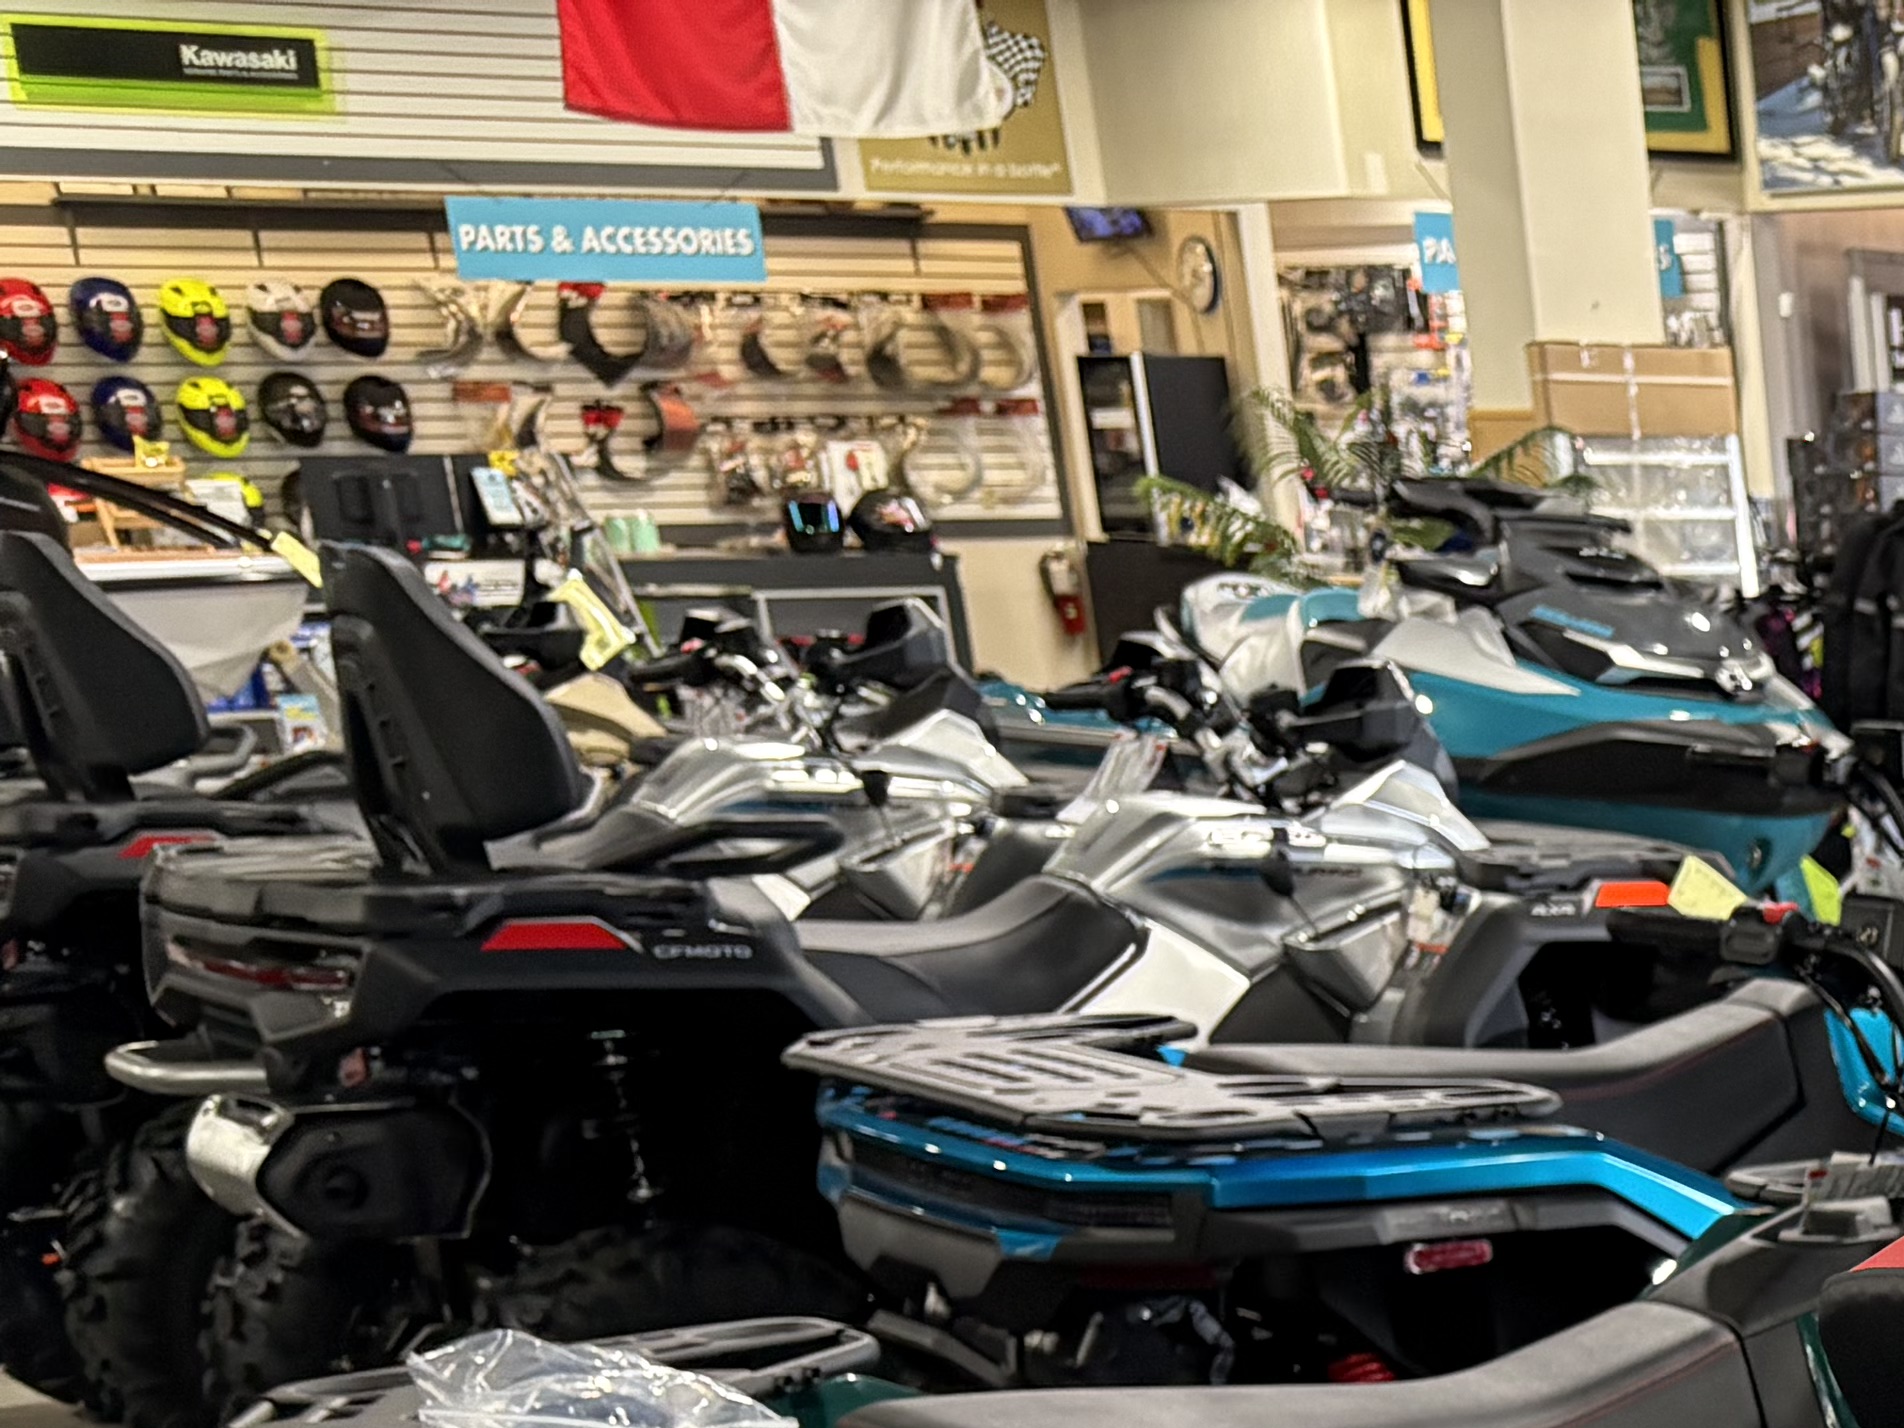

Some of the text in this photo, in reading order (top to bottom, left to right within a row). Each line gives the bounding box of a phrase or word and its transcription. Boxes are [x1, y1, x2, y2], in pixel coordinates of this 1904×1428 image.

[180, 44, 298, 70] Kawasaki
[458, 224, 755, 256] PARTS & ACCESSORIES
[653, 944, 753, 960] CFMOTO
